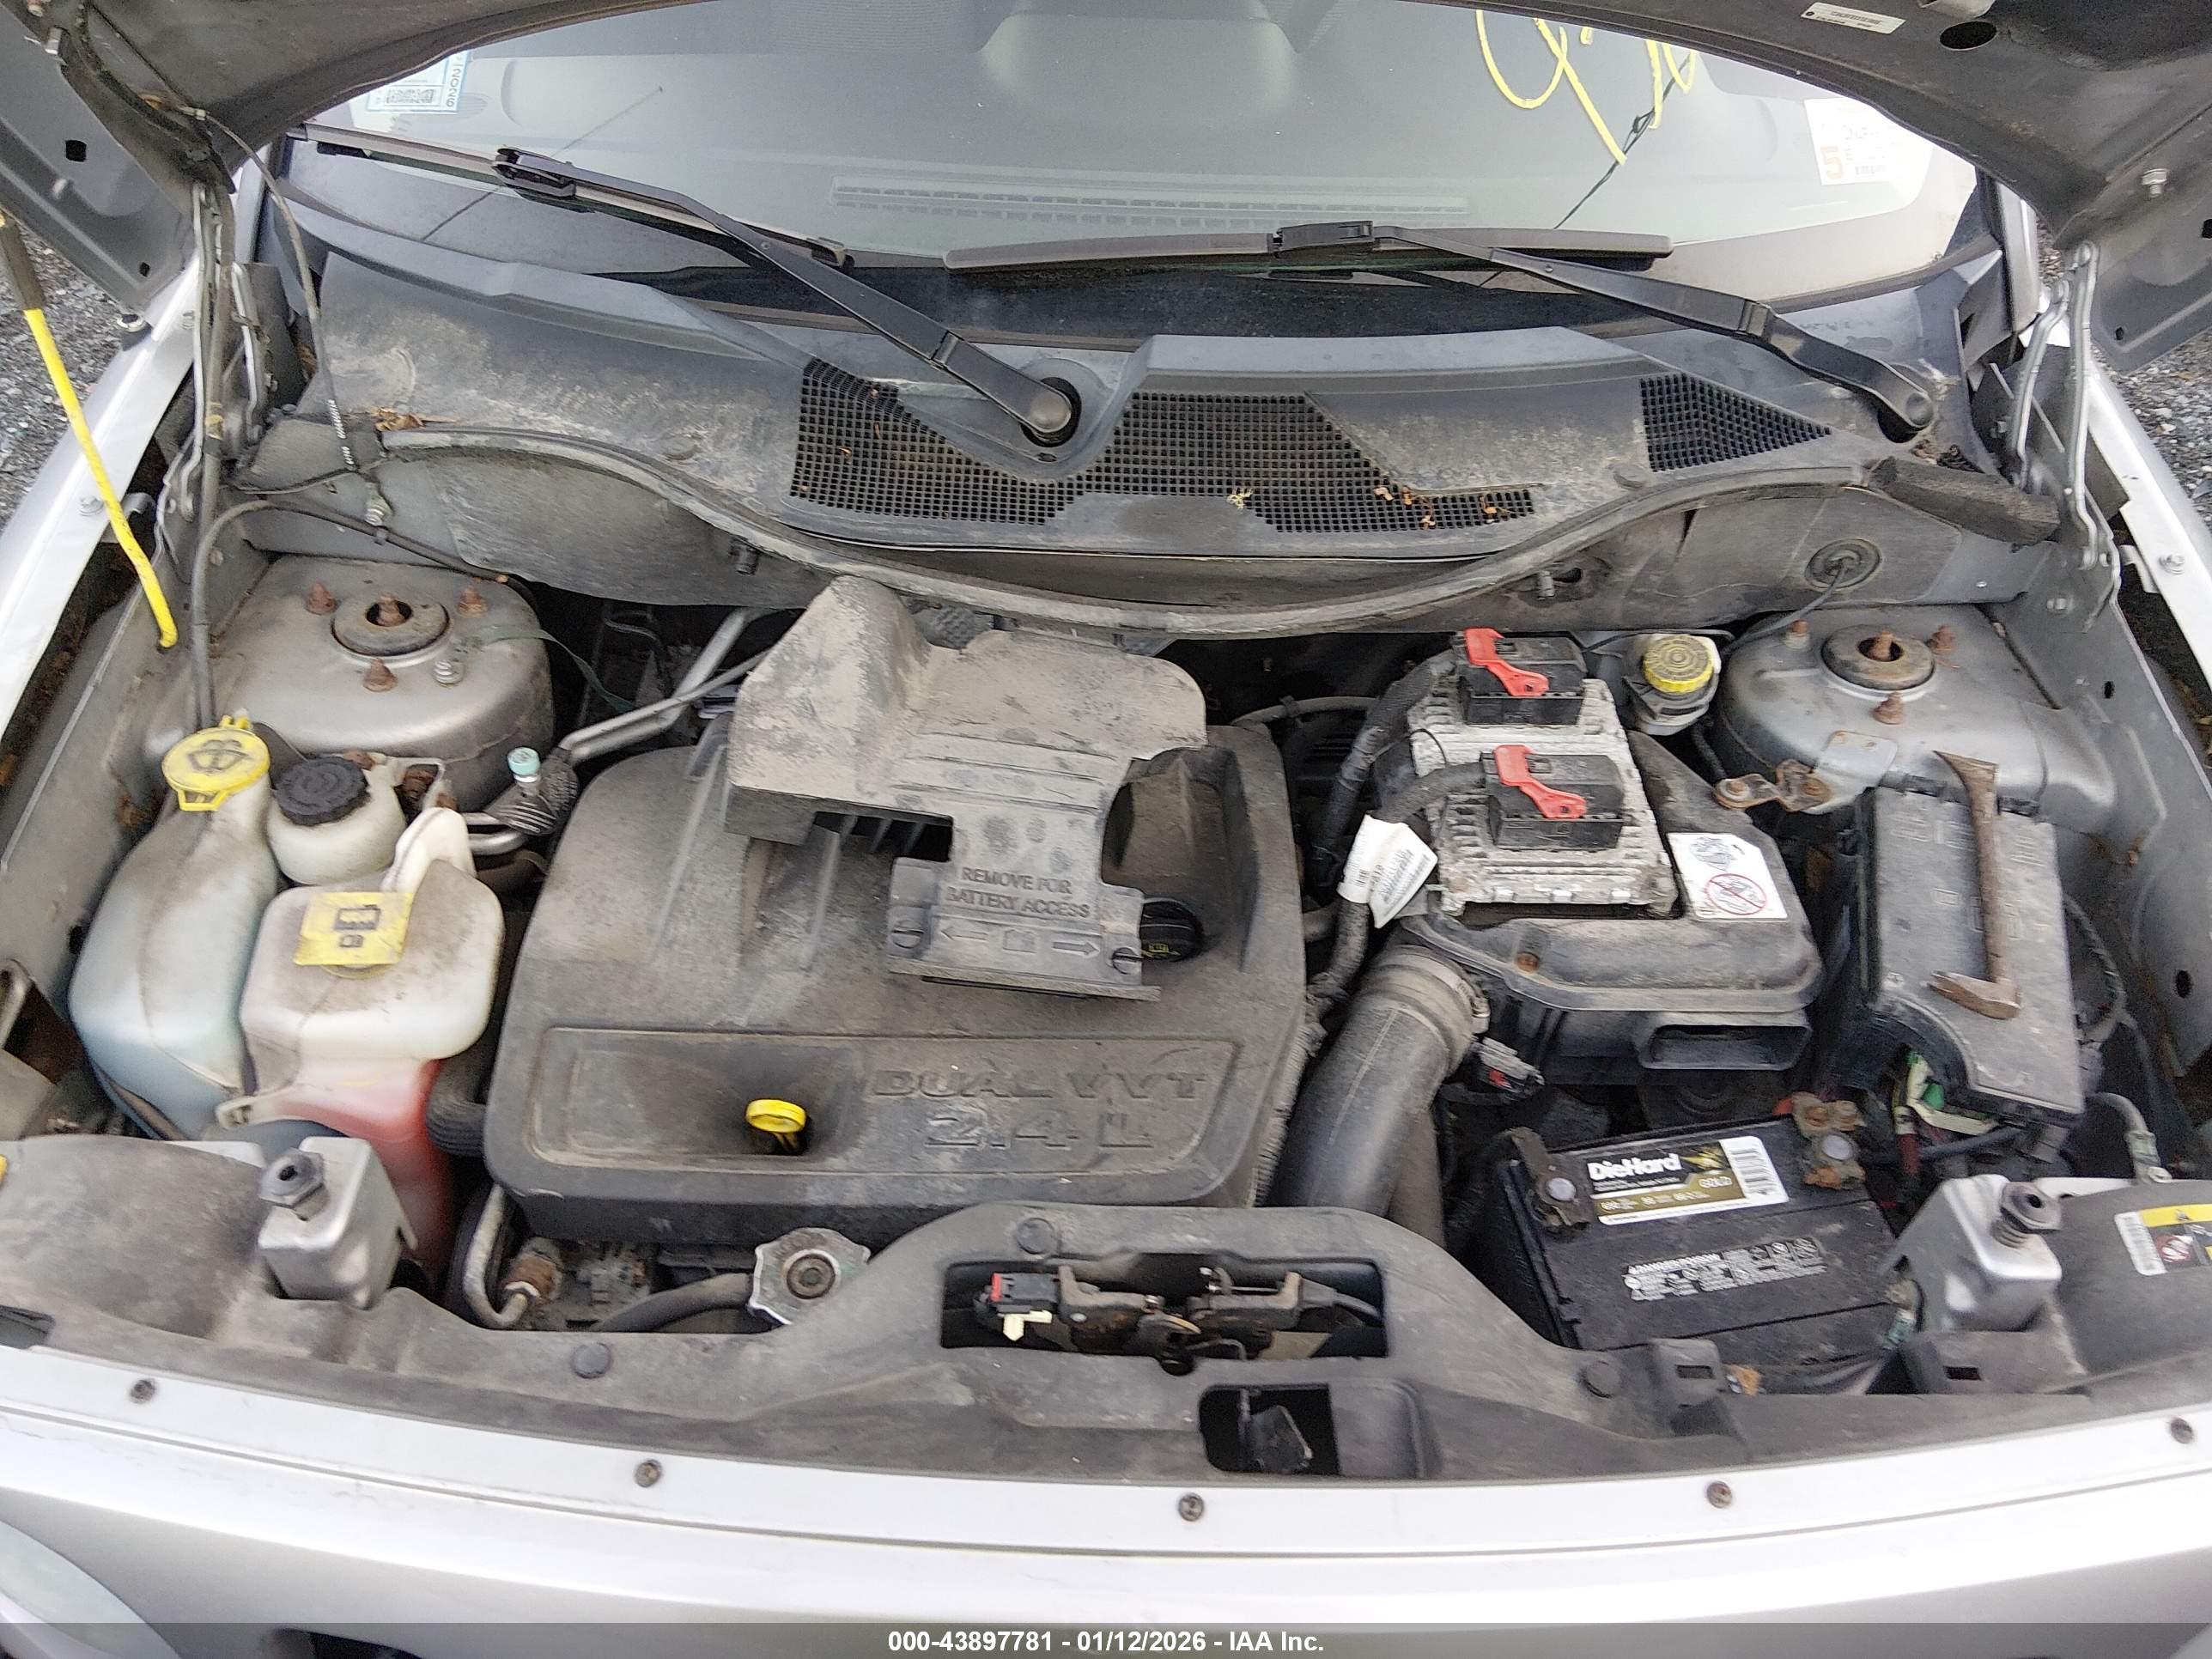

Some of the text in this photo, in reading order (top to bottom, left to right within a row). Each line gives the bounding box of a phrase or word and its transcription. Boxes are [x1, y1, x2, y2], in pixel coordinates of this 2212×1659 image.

[1820, 145, 1844, 179] 5
[961, 866, 1073, 895] REMOVE FOR
[945, 885, 1091, 919] BATTERY ACCESS
[873, 1070, 1206, 1100] DUAL VVT
[1587, 1152, 1682, 1181] DieHard
